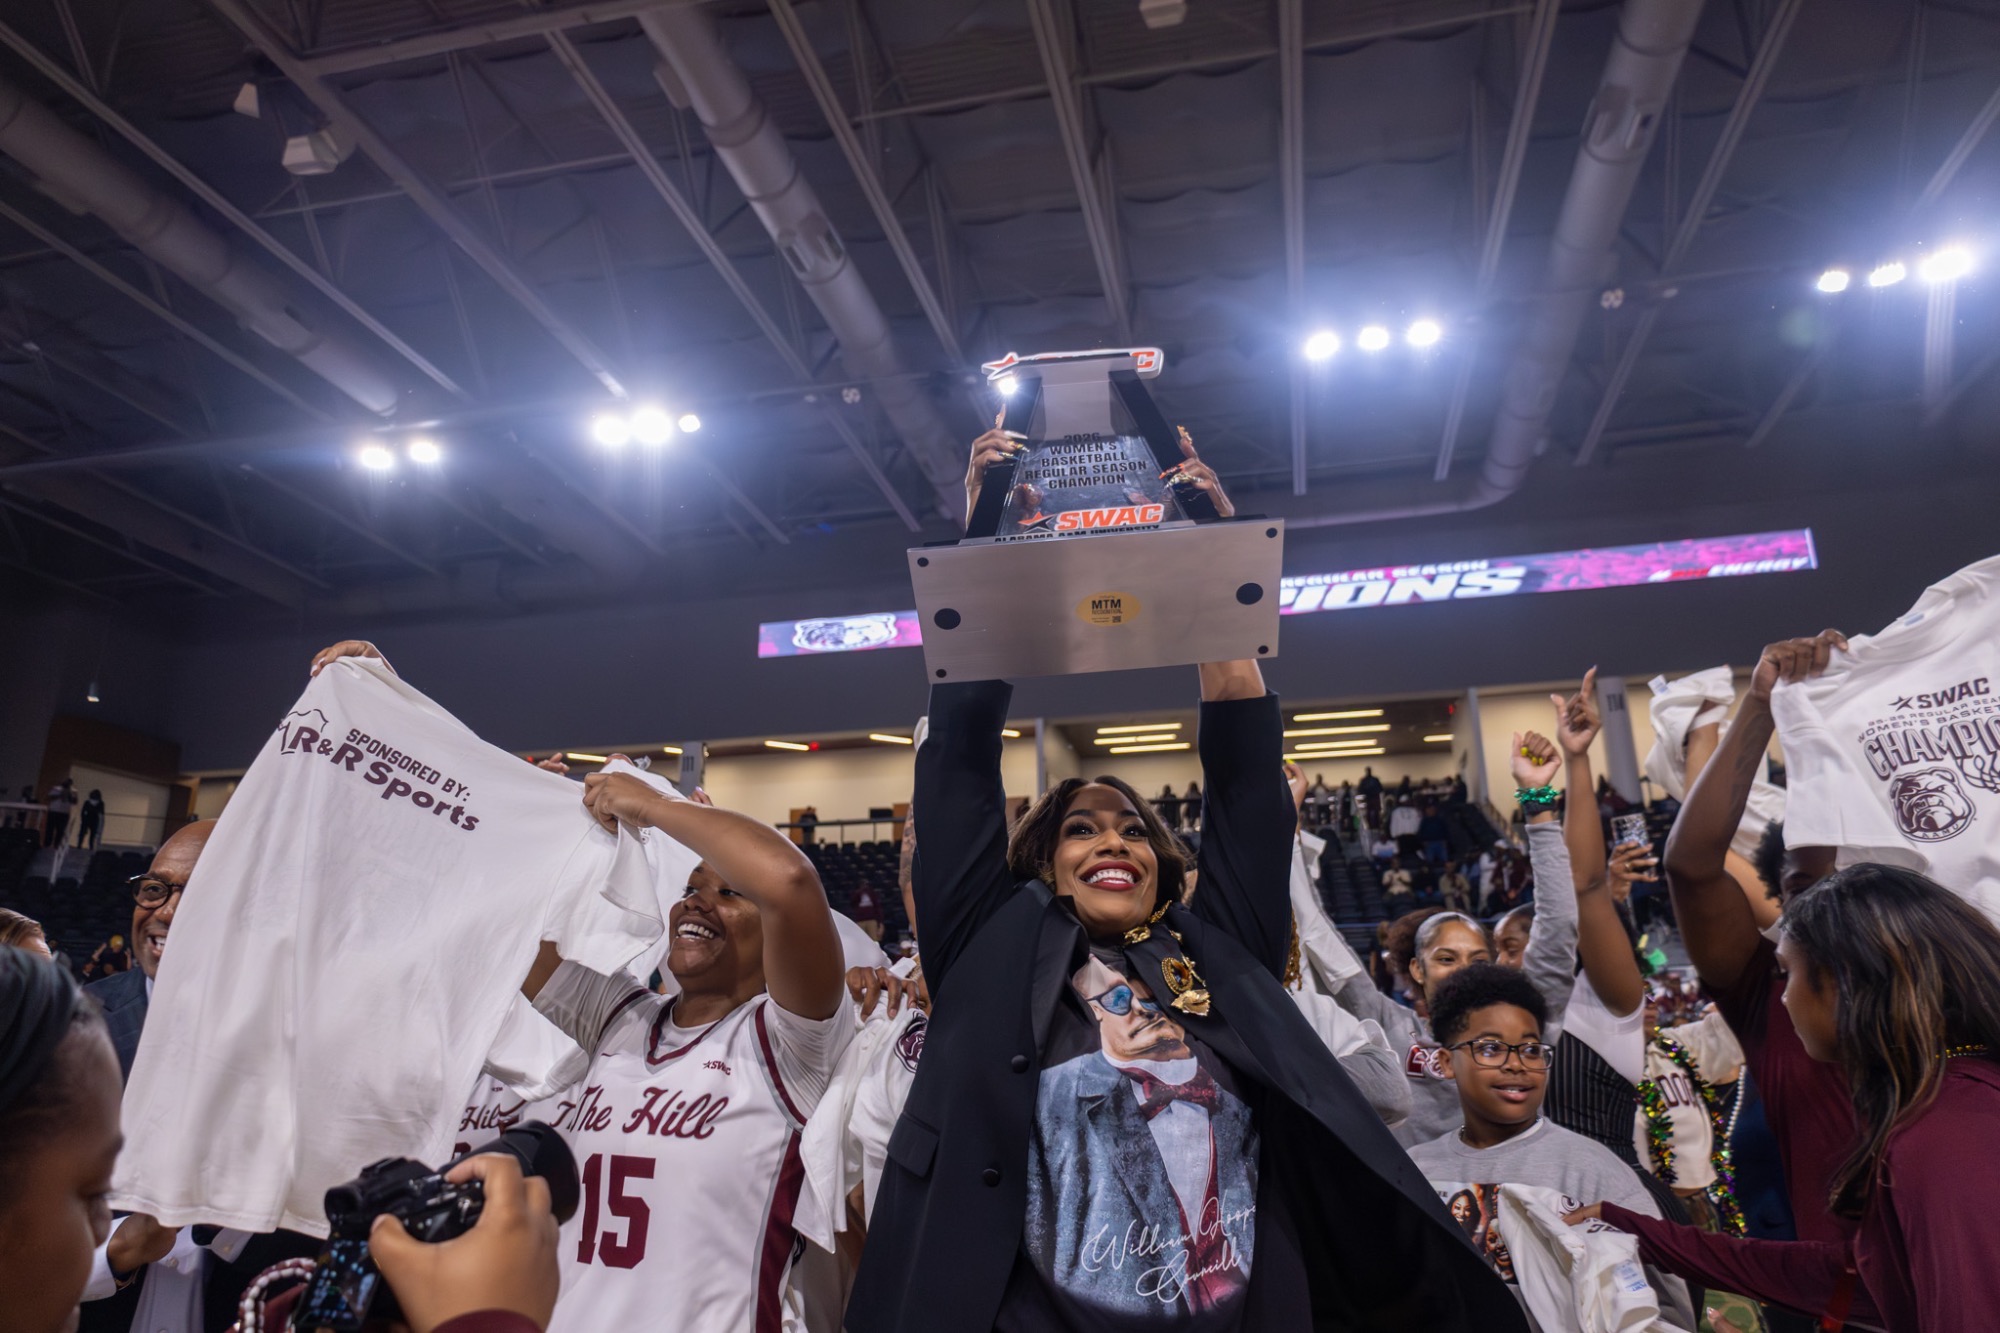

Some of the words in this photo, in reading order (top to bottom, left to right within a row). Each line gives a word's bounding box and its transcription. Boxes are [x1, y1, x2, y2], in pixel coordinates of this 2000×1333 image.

[1049, 441, 1118, 456] WOMEN'S
[1063, 431, 1101, 443] 2026
[1024, 466, 1088, 480] REGULAR
[1092, 460, 1148, 475] SEASON
[1041, 452, 1128, 468] BASKETBALL
[1048, 474, 1127, 490] CHAMPION
[1055, 503, 1164, 531] SWAC
[1091, 599, 1121, 609] MTM
[1917, 677, 1990, 709] SWAC
[1909, 702, 1969, 719] REGULAR
[1973, 695, 2000, 706] SEA
[1857, 718, 1930, 744] WOMEN'S
[287, 725, 365, 773] R&R
[363, 760, 480, 832] Sports
[346, 728, 442, 786] SPONSORED
[441, 777, 471, 802] BY:
[1922, 823, 1960, 839] AAMU
[458, 1103, 505, 1132] Hil
[549, 1083, 613, 1133] The
[622, 1086, 730, 1140] Hill
[576, 1152, 657, 1270] 15
[1080, 1218, 1193, 1273] William
[1135, 1235, 1243, 1303] Councill
